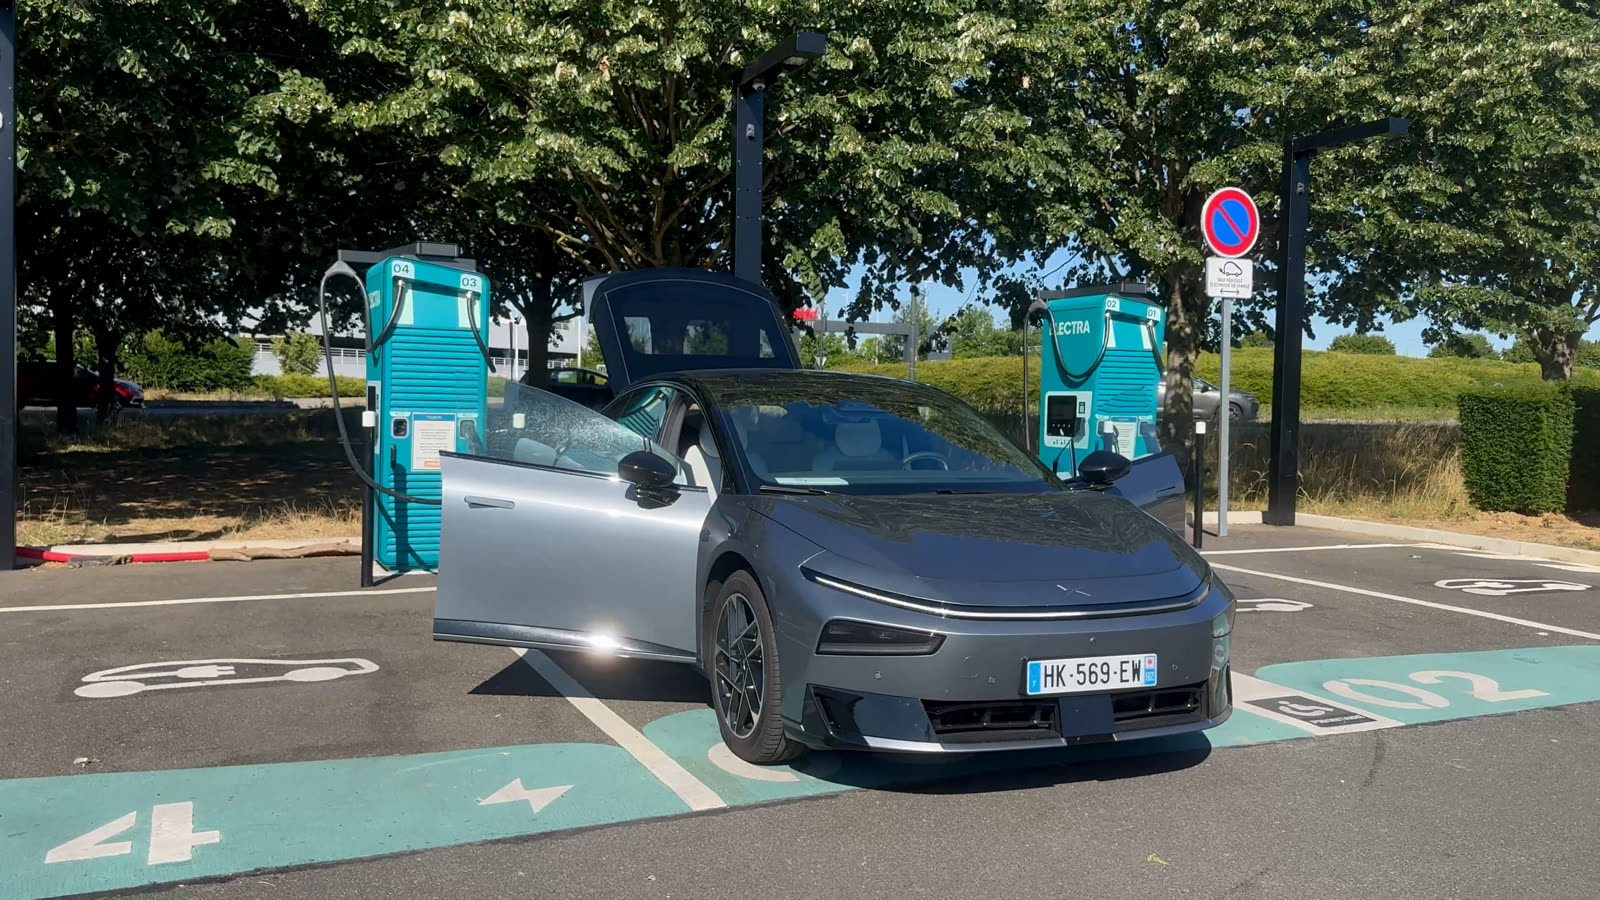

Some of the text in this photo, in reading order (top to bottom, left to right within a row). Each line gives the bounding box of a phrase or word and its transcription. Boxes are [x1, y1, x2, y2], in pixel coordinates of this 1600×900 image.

[393, 264, 409, 273] 04
[461, 277, 477, 287] 03
[1106, 300, 1117, 308] 02
[1323, 670, 1551, 709] 02
[44, 801, 220, 865] 4
